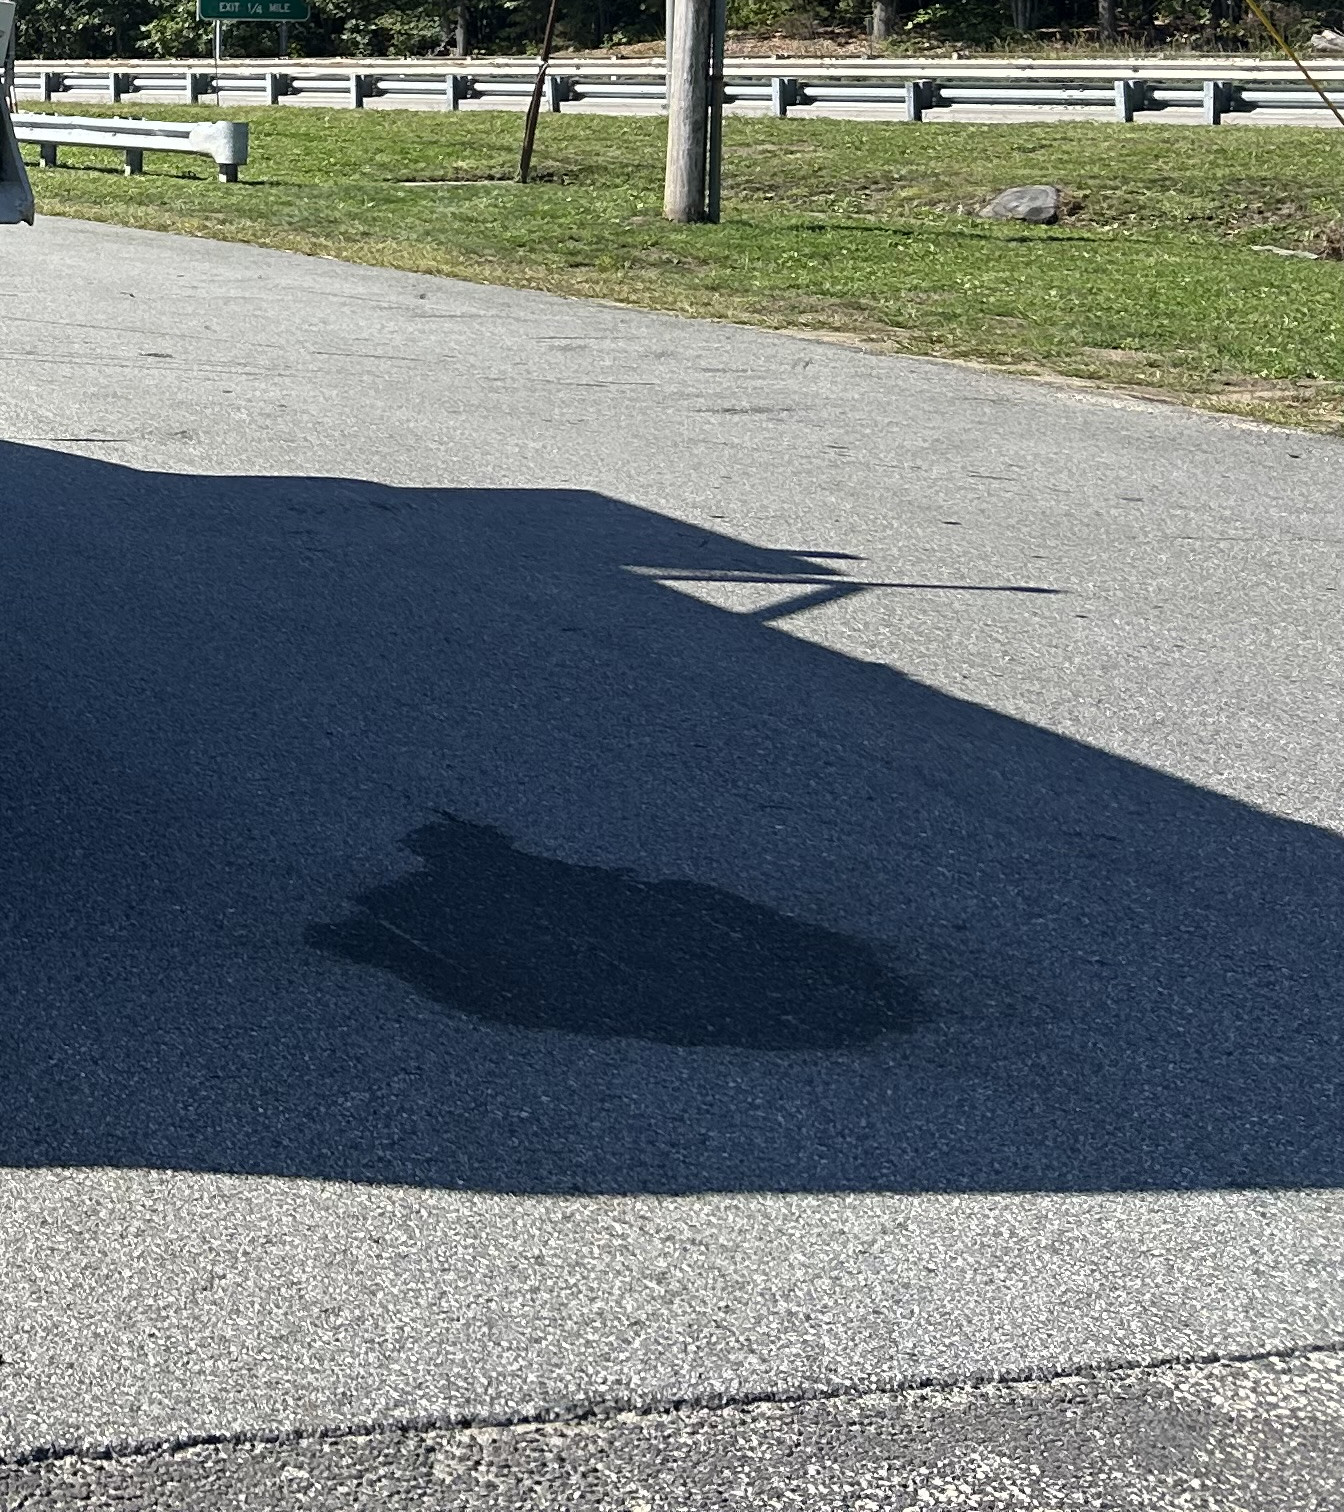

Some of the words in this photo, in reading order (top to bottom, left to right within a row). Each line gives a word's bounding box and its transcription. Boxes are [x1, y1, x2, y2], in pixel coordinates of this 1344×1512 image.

[219, 2, 240, 12] EXIT
[247, 3, 262, 14] 1/4
[269, 3, 291, 13] MILE
